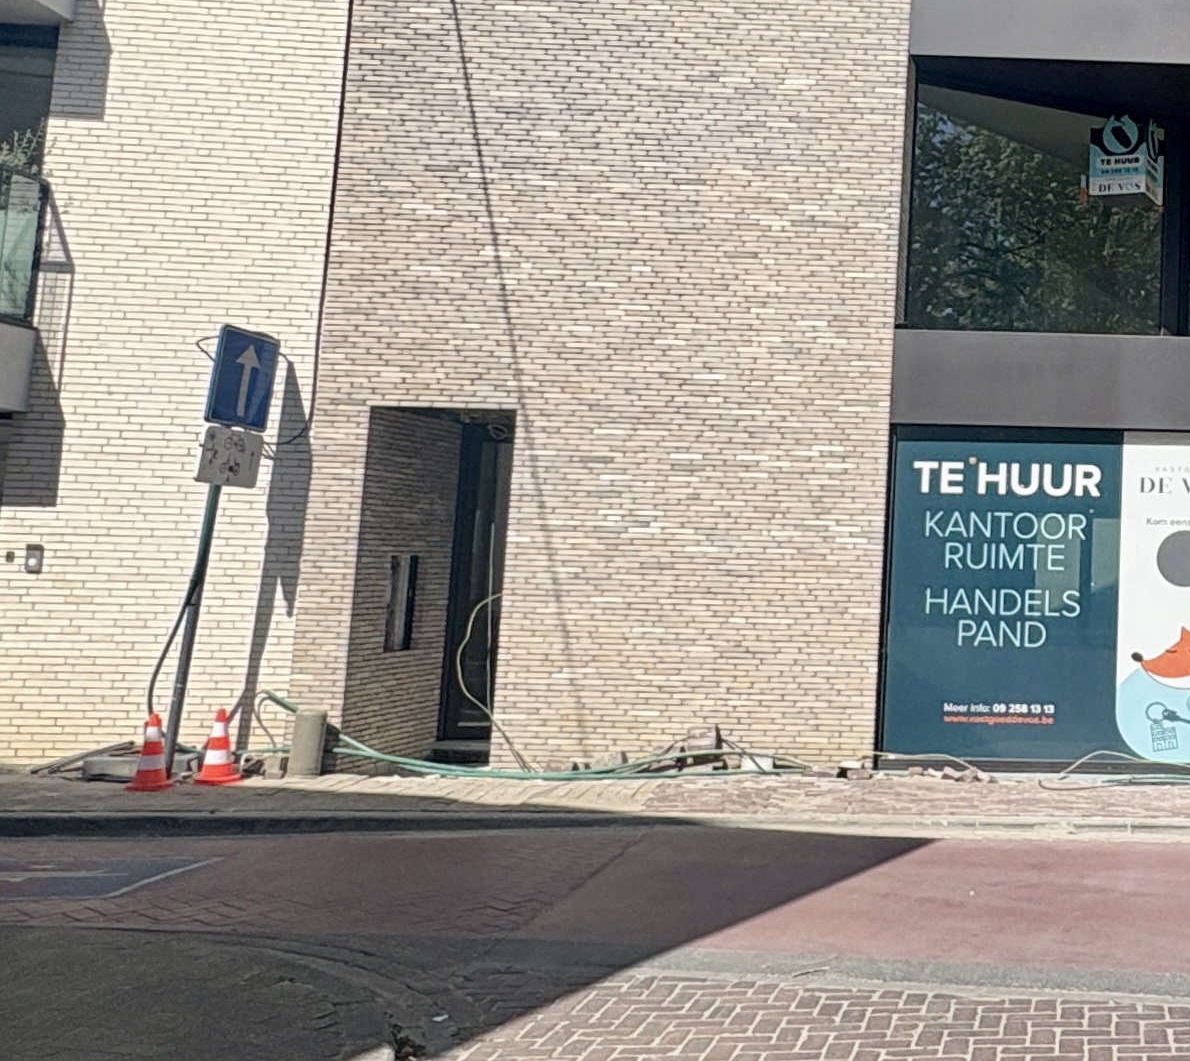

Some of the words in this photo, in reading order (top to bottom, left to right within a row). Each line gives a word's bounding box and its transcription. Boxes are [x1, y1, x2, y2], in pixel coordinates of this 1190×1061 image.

[1114, 157, 1139, 165] HUUR
[913, 460, 964, 495] TE
[978, 461, 1103, 498] HUUR
[1139, 476, 1173, 494] DE
[924, 510, 1087, 541] KANTOOR
[1146, 517, 1167, 526] Kom
[944, 542, 1066, 571] RUIMTE
[924, 588, 1081, 618] HANDELS
[957, 620, 1047, 648] PAND
[943, 703, 968, 712] Meer
[970, 703, 990, 713] info:
[992, 703, 1006, 713] 09
[1008, 703, 1028, 713] 258
[1030, 704, 1041, 714] 13
[1043, 704, 1055, 714] 13
